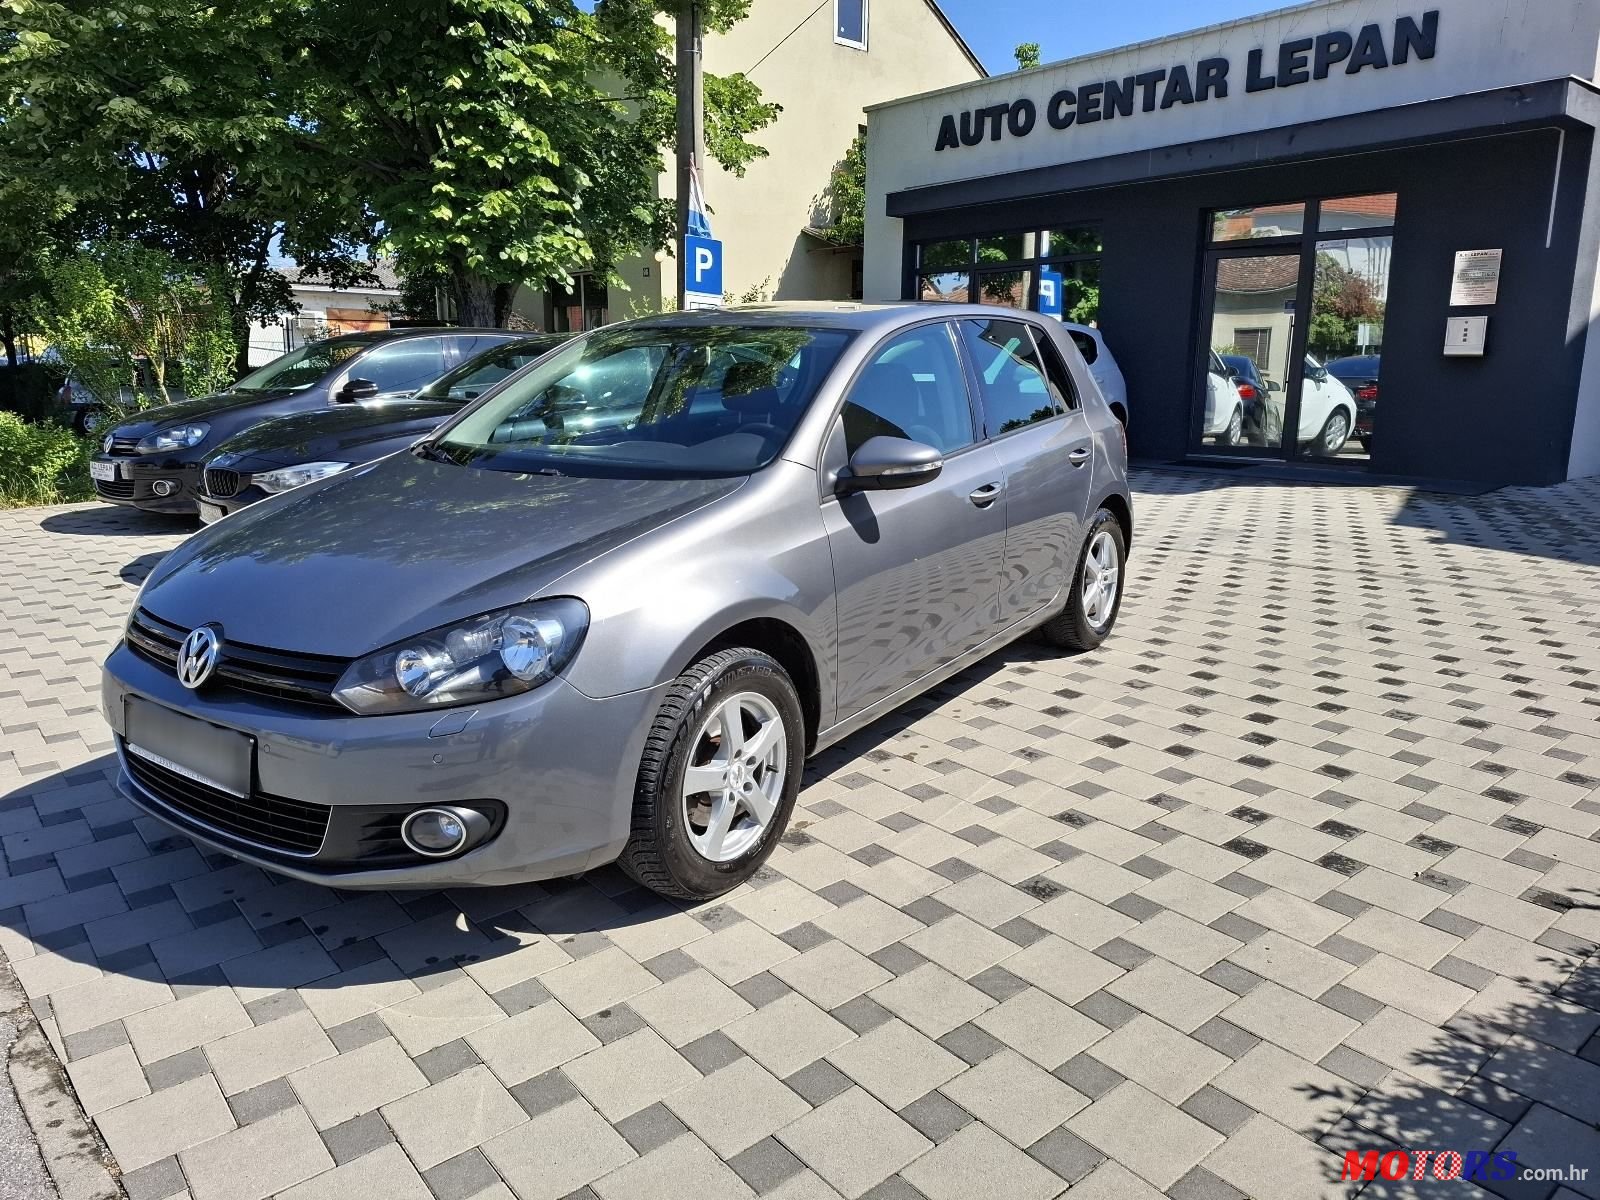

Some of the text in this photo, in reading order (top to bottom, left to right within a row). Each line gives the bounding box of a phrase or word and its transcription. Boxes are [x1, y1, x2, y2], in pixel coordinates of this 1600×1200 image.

[935, 10, 1440, 152] AUTO CENTAR LEPAN
[695, 246, 713, 283] P
